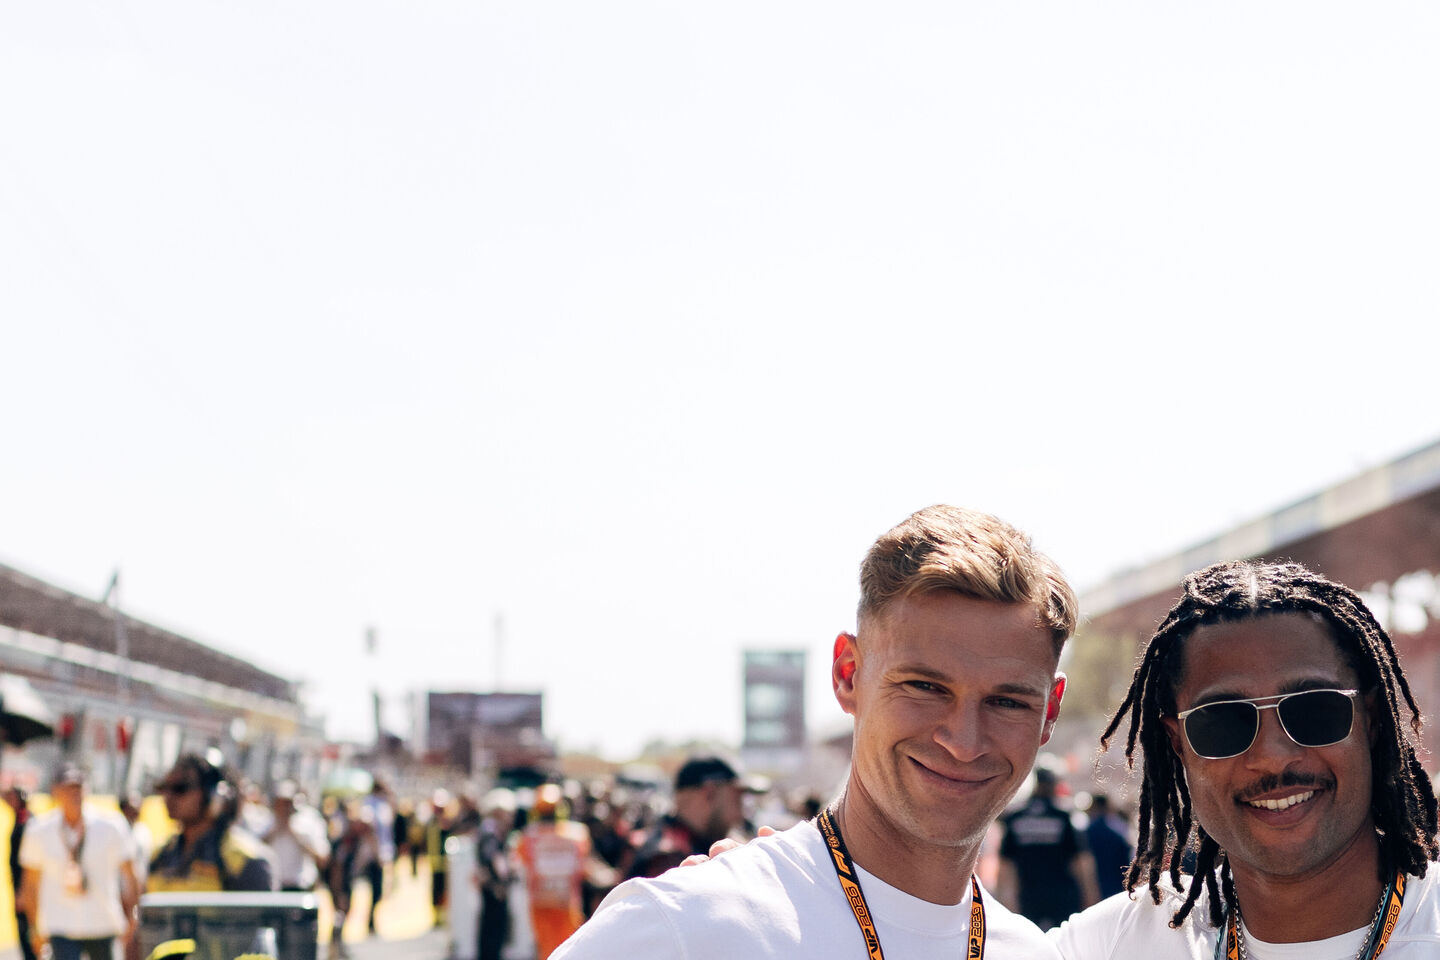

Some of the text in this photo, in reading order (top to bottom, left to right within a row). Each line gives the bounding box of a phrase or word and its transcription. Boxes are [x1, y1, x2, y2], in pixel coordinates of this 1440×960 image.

[848, 886, 871, 926] 2026
[865, 928, 878, 954] VIP
[968, 938, 981, 958] VIP
